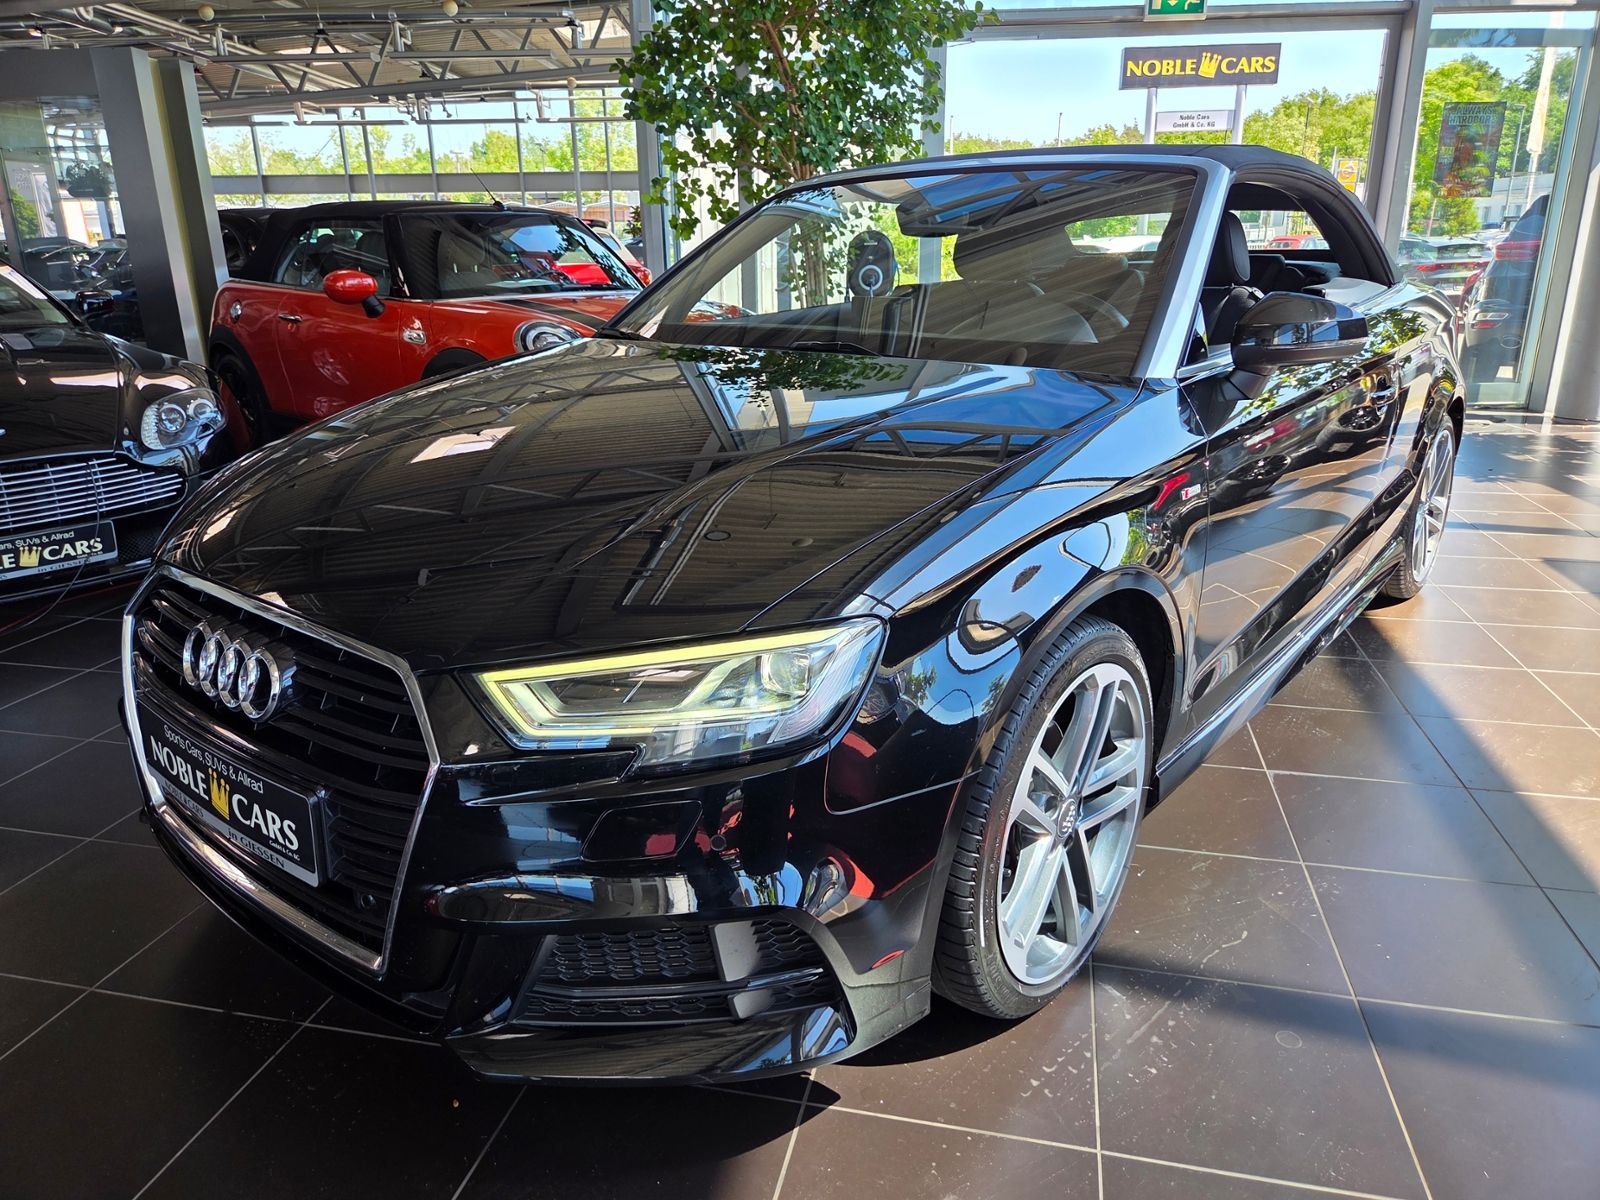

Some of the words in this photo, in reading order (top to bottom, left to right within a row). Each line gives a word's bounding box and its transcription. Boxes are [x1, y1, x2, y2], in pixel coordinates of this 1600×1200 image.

[1126, 59, 1197, 77] NOBLE
[1220, 56, 1276, 74] CARS
[15, 537, 41, 548] SUVs
[41, 535, 50, 543] &
[51, 530, 75, 541] Allrad
[42, 537, 103, 560] CARS
[163, 725, 186, 750] Sports
[204, 752, 228, 776] SUVs
[228, 765, 237, 781] &
[237, 771, 264, 794] Allrad
[150, 735, 209, 801] NOBLE
[231, 793, 299, 851] CARS
[228, 827, 238, 841] in
[240, 836, 285, 868] GIESSEN
